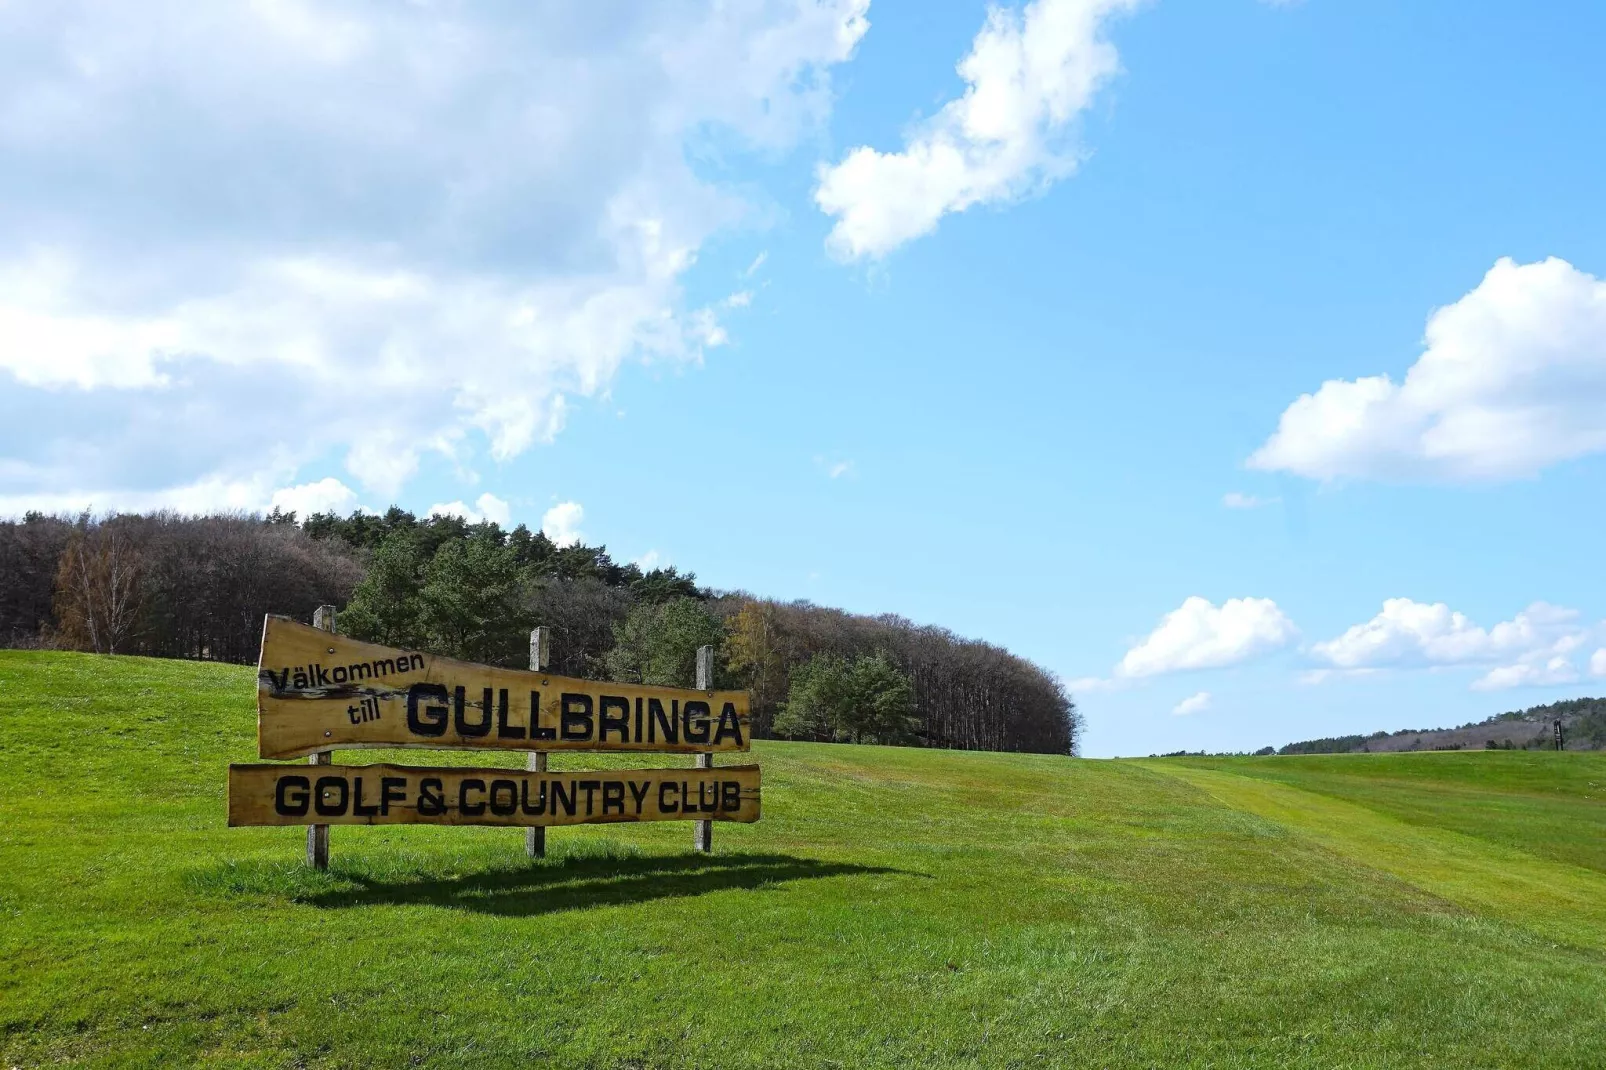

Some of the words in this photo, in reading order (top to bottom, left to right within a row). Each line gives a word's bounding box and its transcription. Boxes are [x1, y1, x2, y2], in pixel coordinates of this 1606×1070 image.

[268, 652, 425, 693] Välkommen
[347, 697, 381, 725] till
[407, 682, 744, 747] GULLBRINGA
[274, 775, 408, 818] GOLF
[416, 777, 448, 817] &
[458, 778, 652, 817] COUNTRY
[658, 780, 741, 814] CLUB
